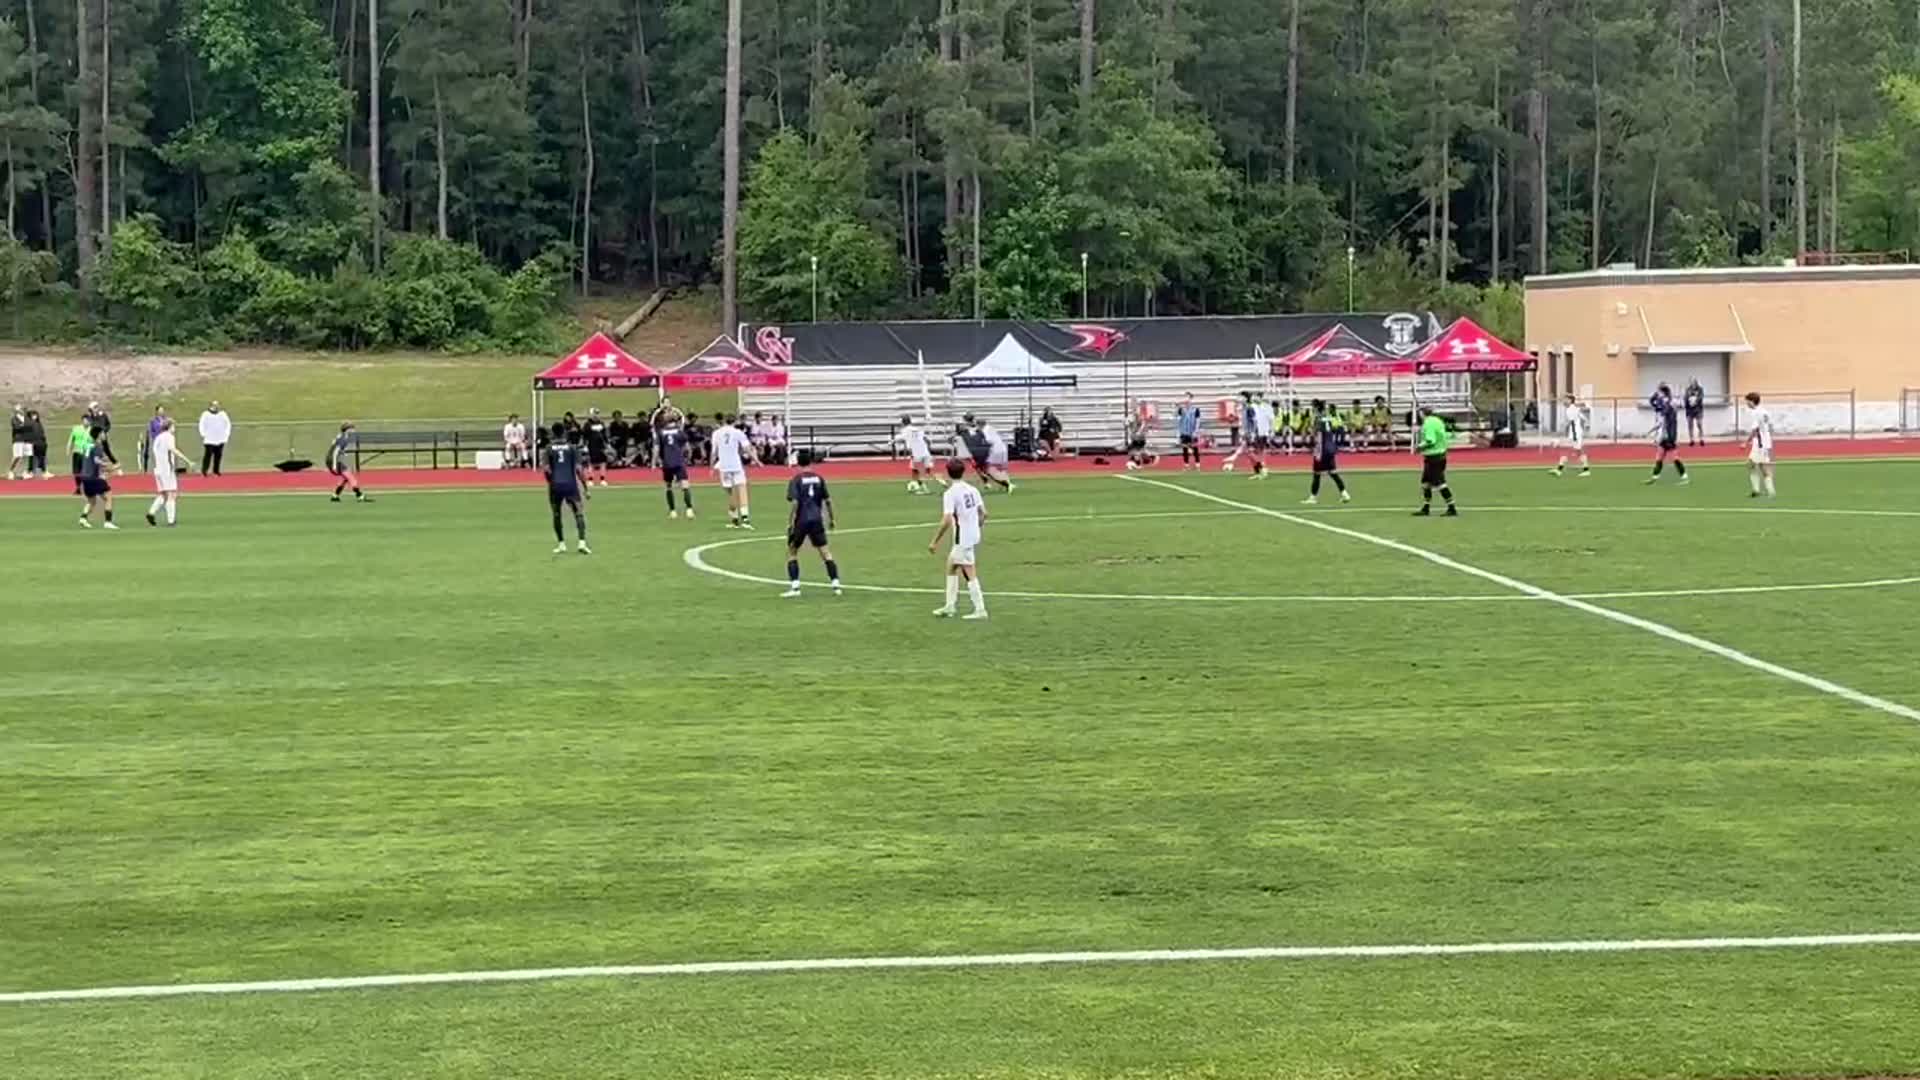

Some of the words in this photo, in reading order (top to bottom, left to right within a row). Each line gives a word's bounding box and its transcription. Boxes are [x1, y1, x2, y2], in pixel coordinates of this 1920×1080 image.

[554, 378, 595, 388] TRACK
[607, 376, 640, 387] FIELD
[963, 493, 976, 509] 21
